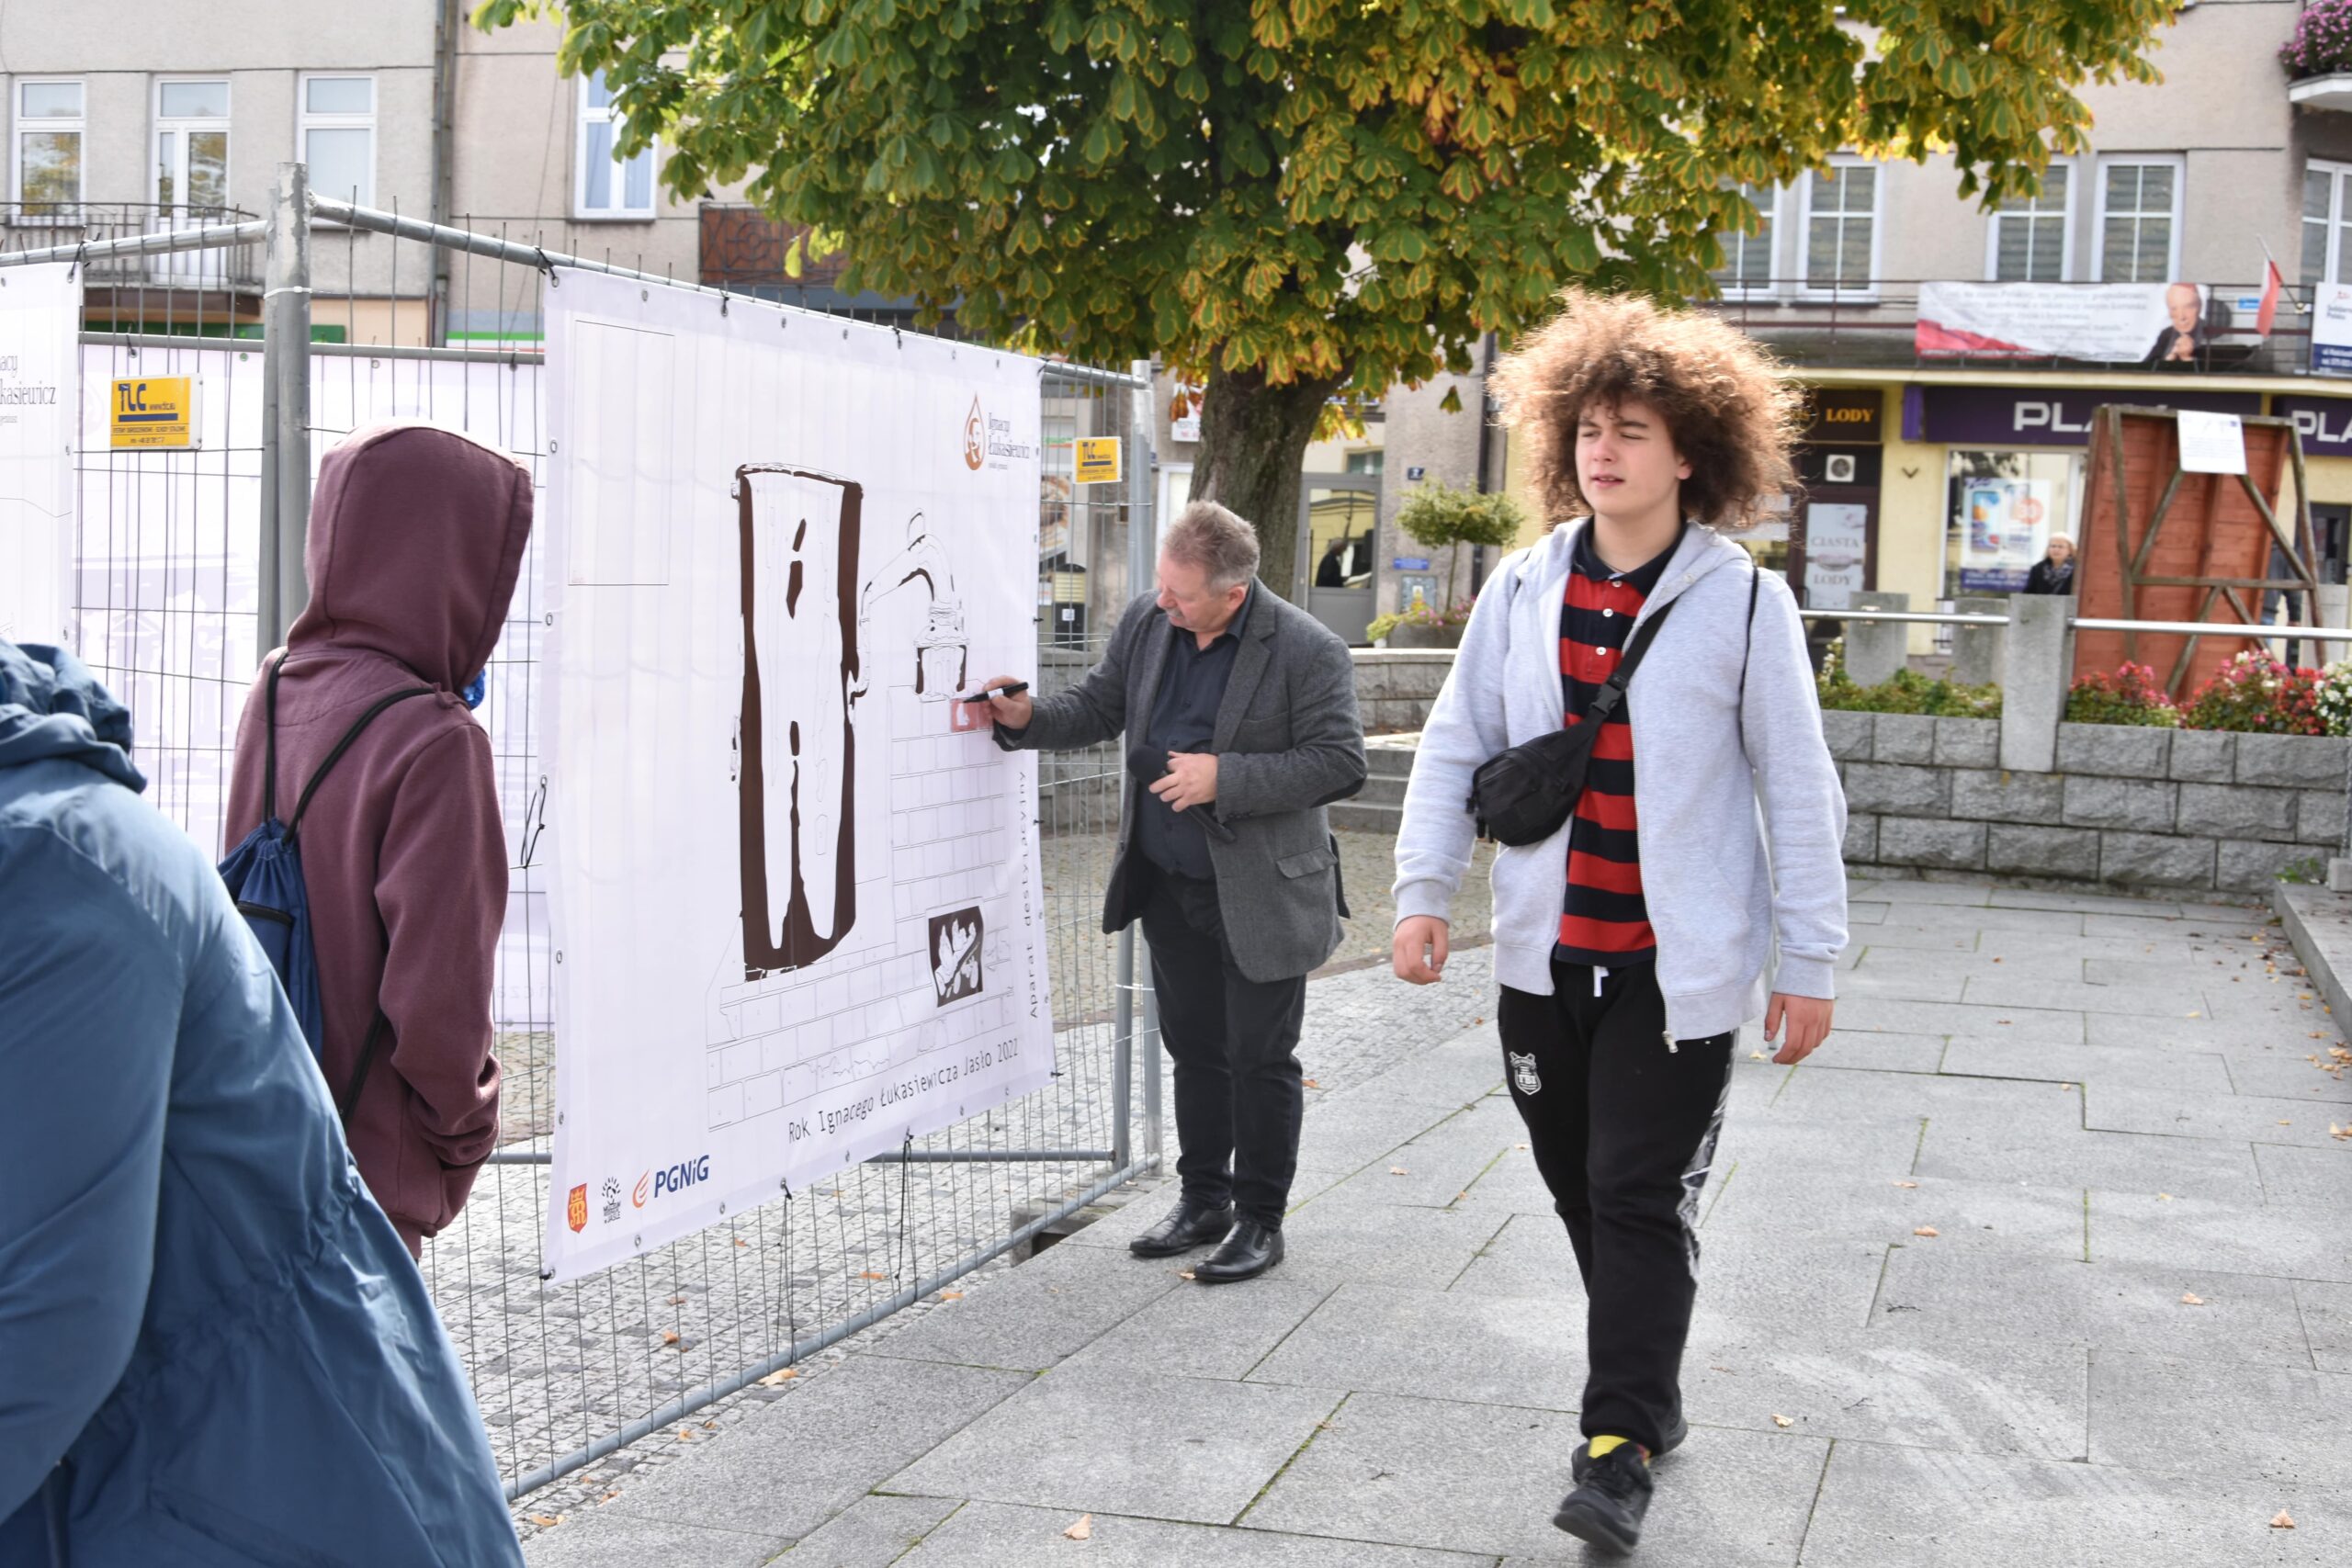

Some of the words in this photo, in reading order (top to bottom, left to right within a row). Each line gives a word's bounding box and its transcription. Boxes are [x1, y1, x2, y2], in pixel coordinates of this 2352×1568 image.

[118, 383, 146, 412] TLC
[1826, 408, 1873, 422] LODY
[2013, 401, 2110, 433] PL
[1811, 536, 1860, 548] CIASTA
[1813, 573, 1853, 586] LODY
[1026, 943, 1038, 1019] Aparat
[788, 1116, 810, 1144] Rok
[818, 1096, 874, 1134] Ignacego
[879, 1065, 958, 1108] Łukasiewicza
[963, 1050, 992, 1077] Jasło
[997, 1038, 1019, 1063] 2022
[654, 1155, 709, 1198] PGNiG
